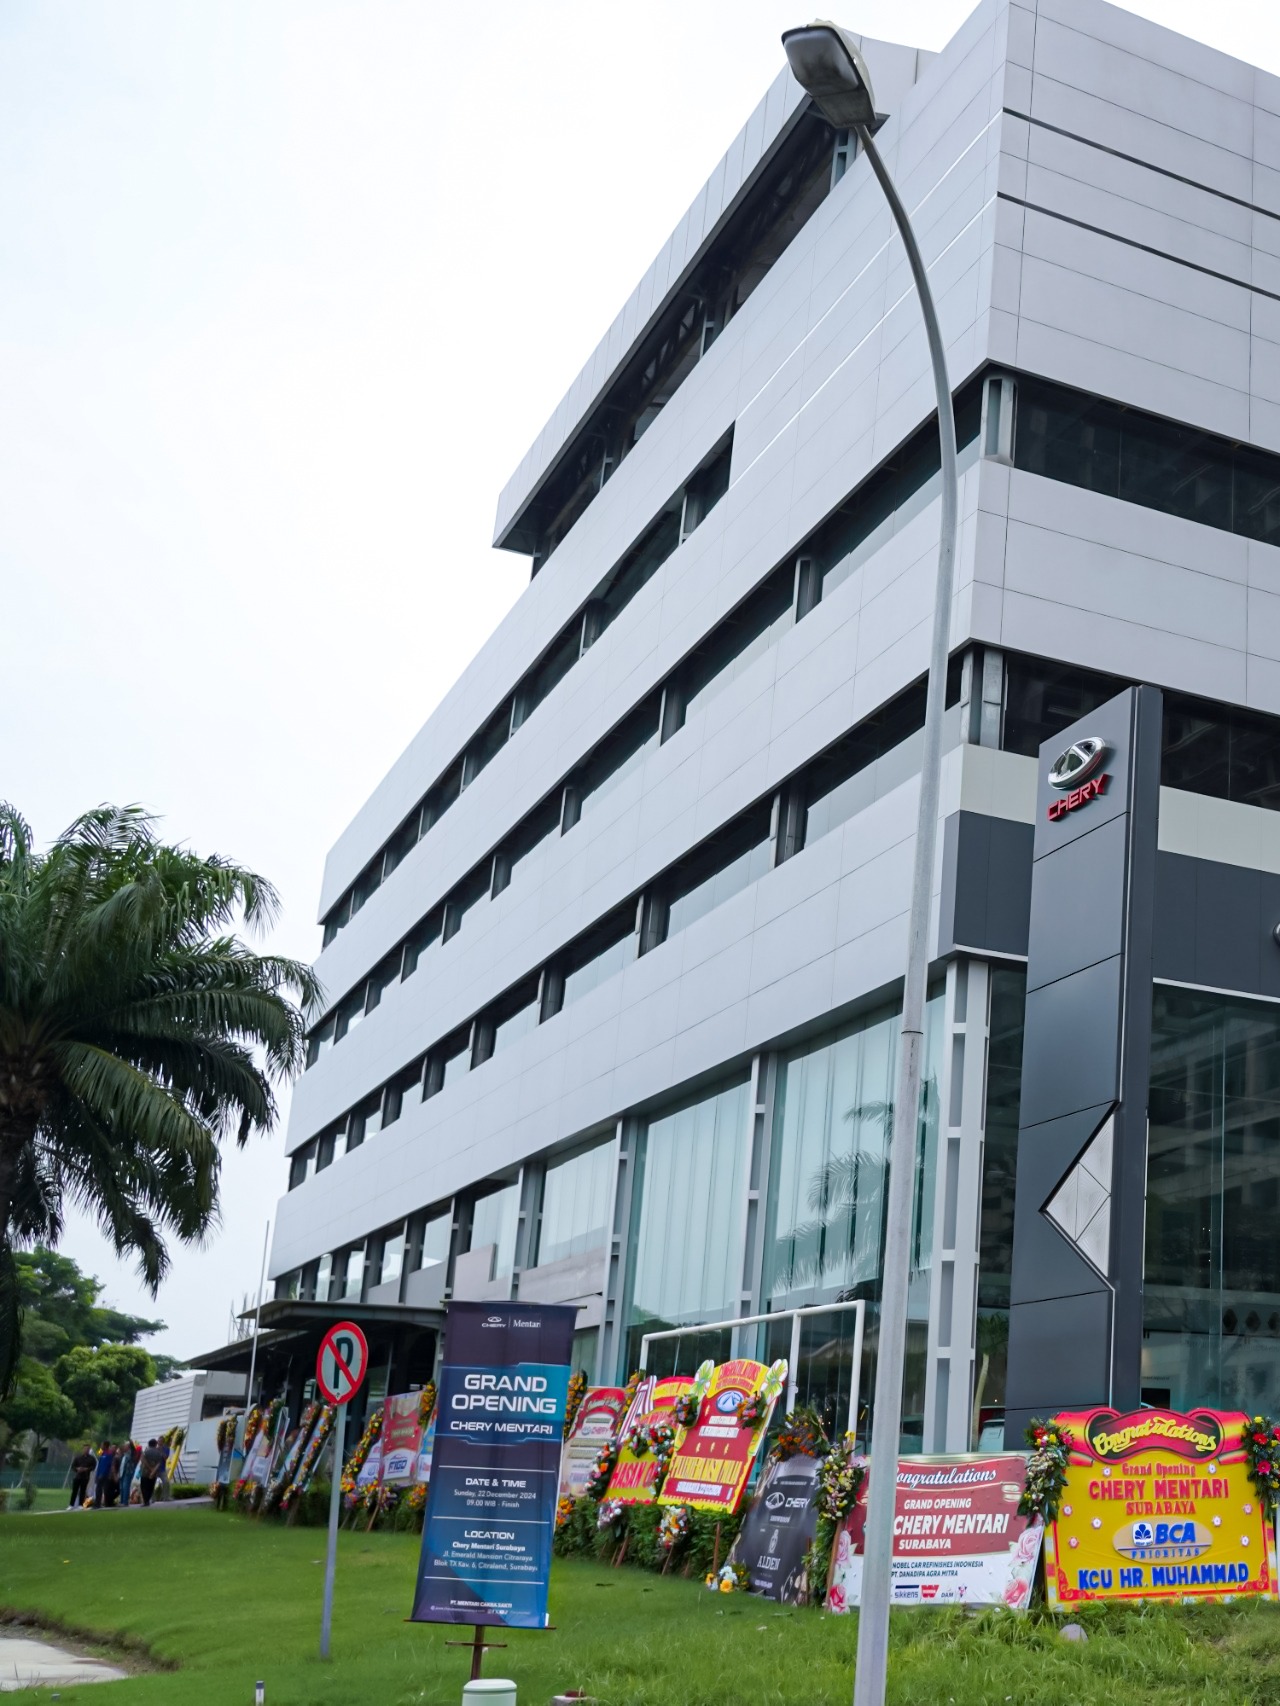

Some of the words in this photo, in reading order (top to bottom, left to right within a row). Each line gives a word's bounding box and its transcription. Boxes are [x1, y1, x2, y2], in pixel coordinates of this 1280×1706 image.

[1047, 773, 1109, 821] CHERY
[464, 1374, 547, 1392] GRAND
[452, 1394, 557, 1414] OPENING
[450, 1421, 492, 1431] CHERY
[494, 1422, 553, 1434] MENTARI
[1093, 1417, 1216, 1455] Congratulations
[1122, 1463, 1152, 1475] Grand
[1156, 1463, 1195, 1478] Opening
[465, 1478, 490, 1486] DATE
[492, 1479, 498, 1487] &
[502, 1480, 526, 1488] TIME
[896, 1467, 996, 1489] ongratulations
[454, 1489, 476, 1497] Sunday,
[1089, 1480, 1145, 1500] CHERY
[1154, 1479, 1229, 1499] MENTARI
[785, 1498, 810, 1508] CHERY
[904, 1499, 933, 1509] GRAND
[934, 1498, 971, 1509] OPENING
[1126, 1501, 1196, 1515] SURABAYA
[893, 1515, 942, 1535] CHERY
[942, 1513, 1010, 1534] MENTARI
[464, 1530, 515, 1540] LOCATION
[1155, 1523, 1196, 1544] BCA
[452, 1541, 469, 1550] Chery
[495, 1544, 526, 1552] Surabaya
[899, 1539, 951, 1549] SURABAYA
[1131, 1547, 1199, 1559] PRIORITAS
[757, 1556, 781, 1570] ALDEN
[1078, 1569, 1112, 1589] KCU
[1120, 1568, 1148, 1588] HR.
[1152, 1563, 1249, 1586] MUHAMMAD
